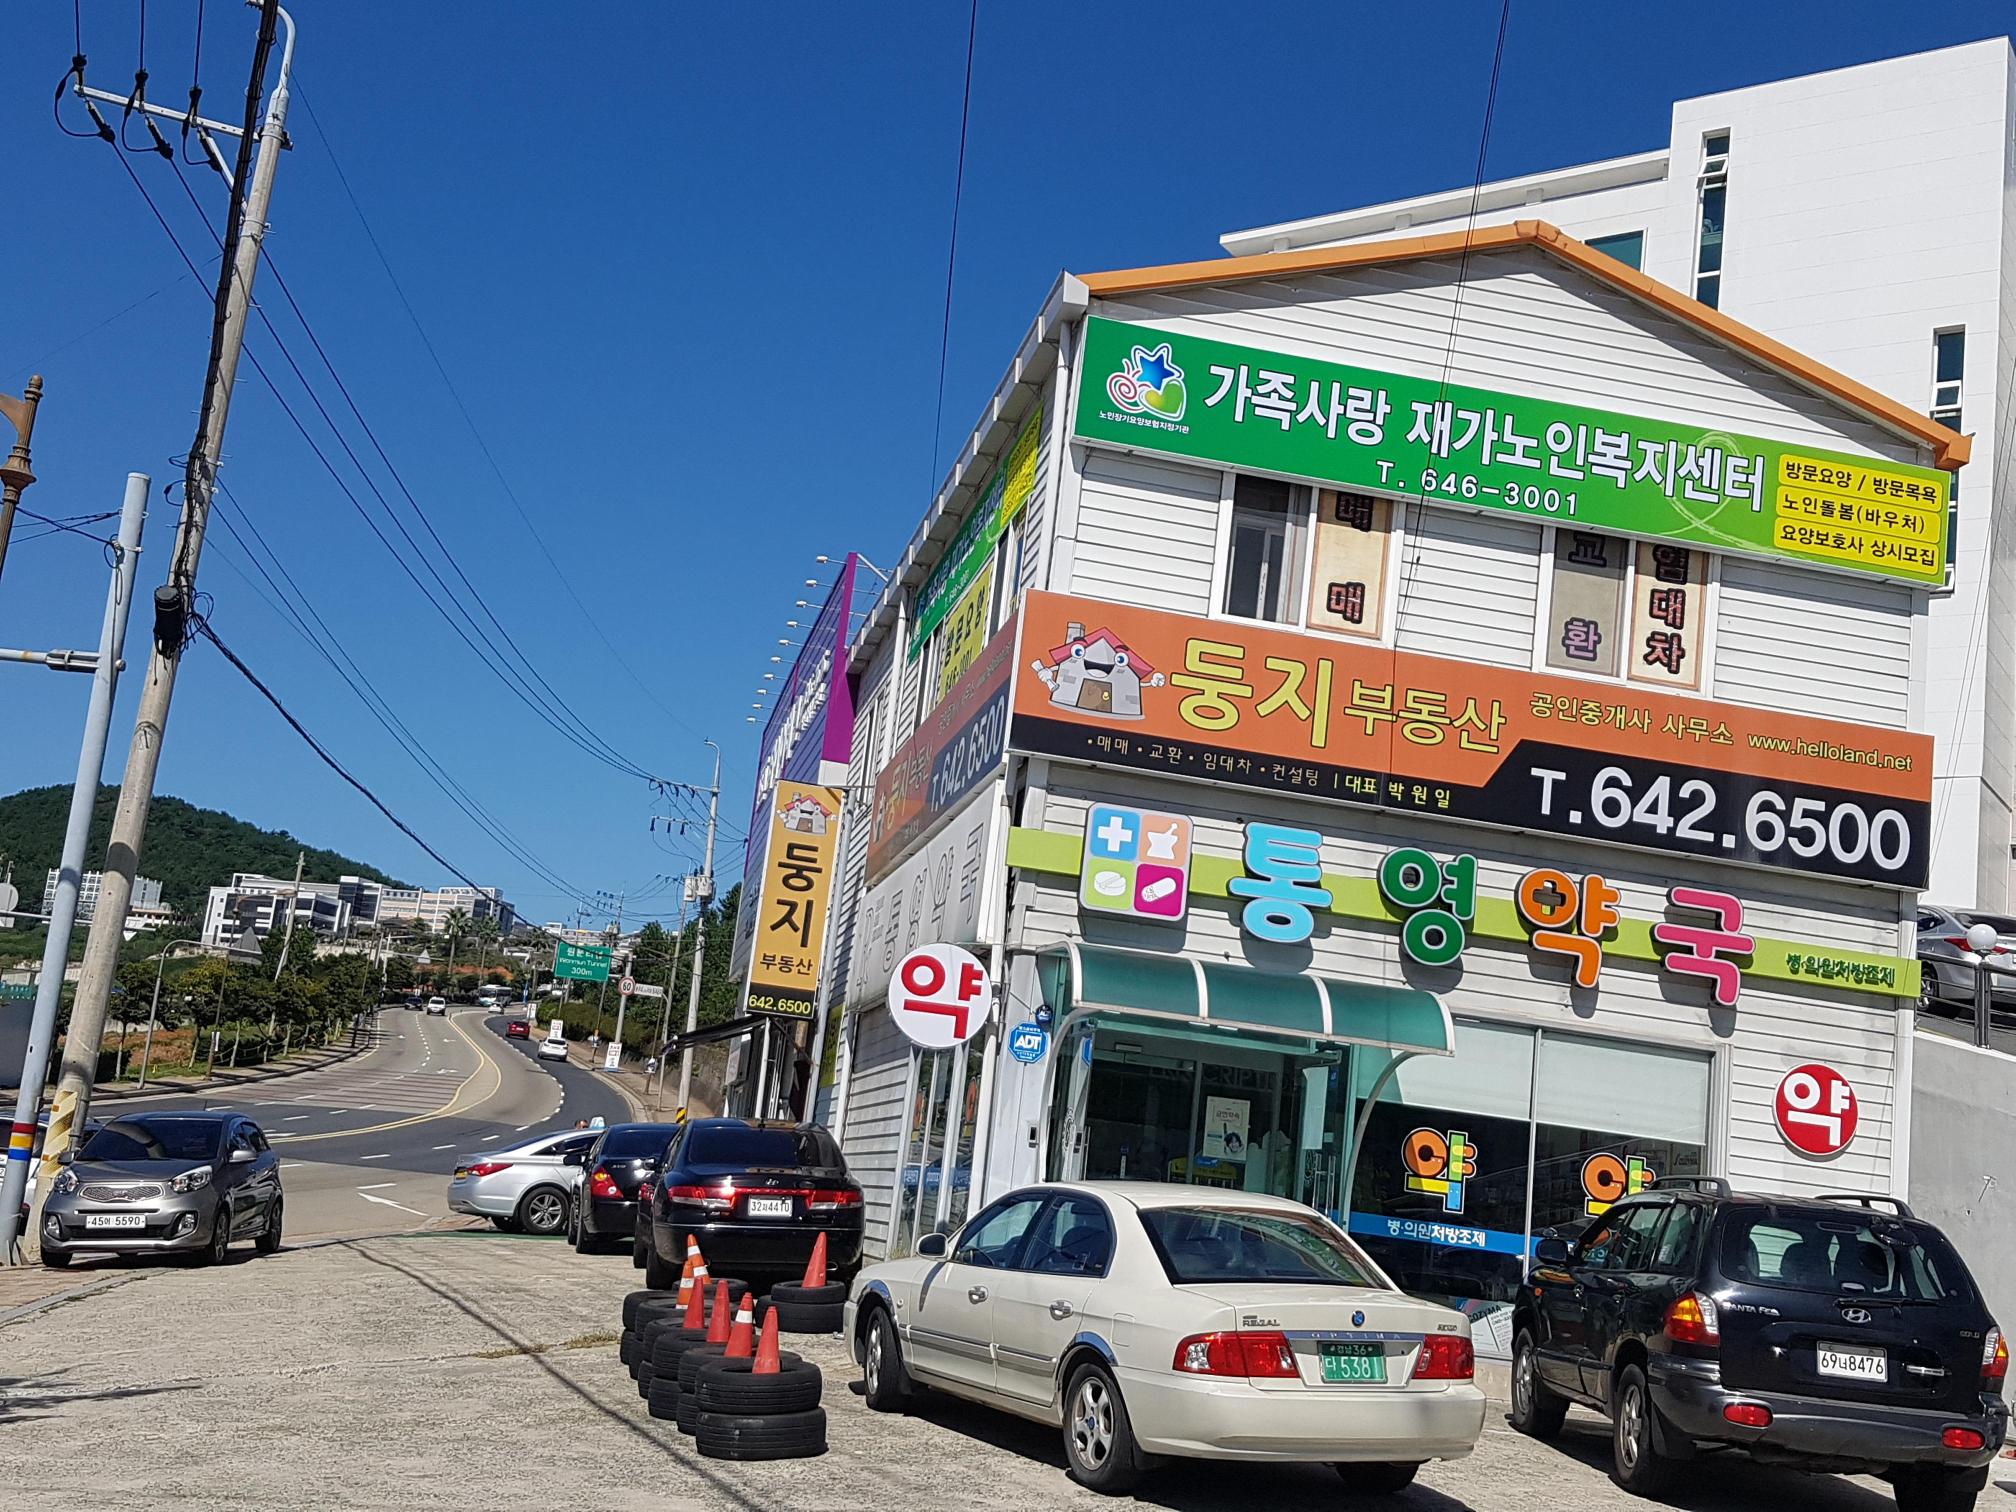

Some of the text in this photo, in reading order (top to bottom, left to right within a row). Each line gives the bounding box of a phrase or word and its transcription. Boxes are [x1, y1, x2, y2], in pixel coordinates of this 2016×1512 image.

[1099, 410, 1190, 434] 노인장기요양보험지정기관
[1204, 363, 1766, 513] 가족사랑 재가노인복지센터
[1420, 468, 1578, 516] 646-3001
[1785, 459, 1853, 489] 방문요양
[1872, 475, 1938, 506] 방문목욕
[1781, 493, 1926, 535] 노인돌봄(바우처)
[1780, 523, 1936, 567] 요양보호사 상시모집
[1170, 637, 1506, 754] 둥지 부동산
[1529, 691, 1913, 772] 공인중개사 사무소 www.helloland.net
[769, 842, 824, 949] 둥지
[1228, 821, 1756, 1006] 통영약국
[622, 982, 632, 991] 60
[759, 952, 814, 977] 부동산
[748, 993, 811, 1015] 642.6500
[901, 954, 984, 1040] 약
[1014, 1035, 1042, 1050] ADT
[1783, 1072, 1851, 1147] 약
[1402, 1126, 1478, 1215] 약
[115, 1216, 140, 1226] 5590
[1352, 1345, 1367, 1355] 36
[1820, 1352, 1884, 1375] 69너8476
